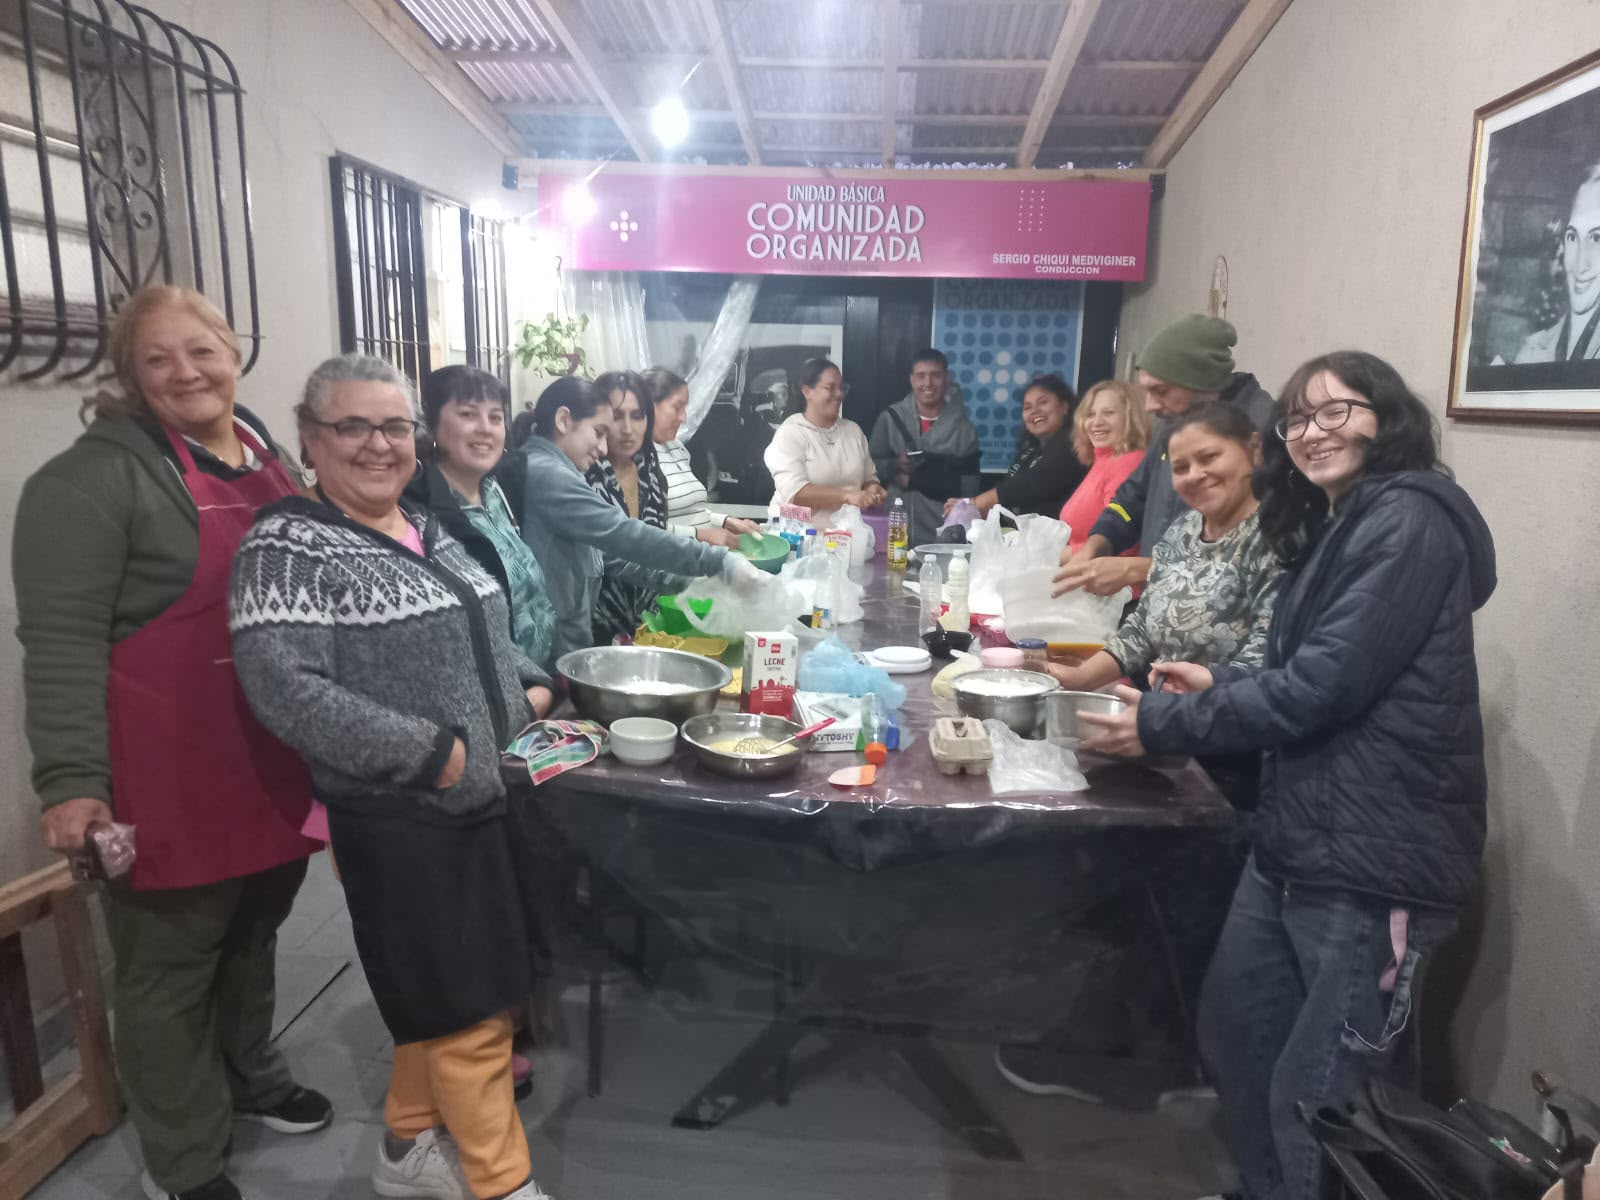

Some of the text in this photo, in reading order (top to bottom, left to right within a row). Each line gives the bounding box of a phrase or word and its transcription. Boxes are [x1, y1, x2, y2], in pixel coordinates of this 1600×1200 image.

[787, 182, 885, 203] UNIDAD BÁSICA
[747, 203, 925, 234] COMUNIDAD
[746, 233, 922, 262] ORGANIZADA
[992, 253, 1136, 266] SERGIO CHIQUI MEDVIGINER
[1035, 265, 1100, 274] CONDUCCION
[764, 657, 785, 666] LECHE
